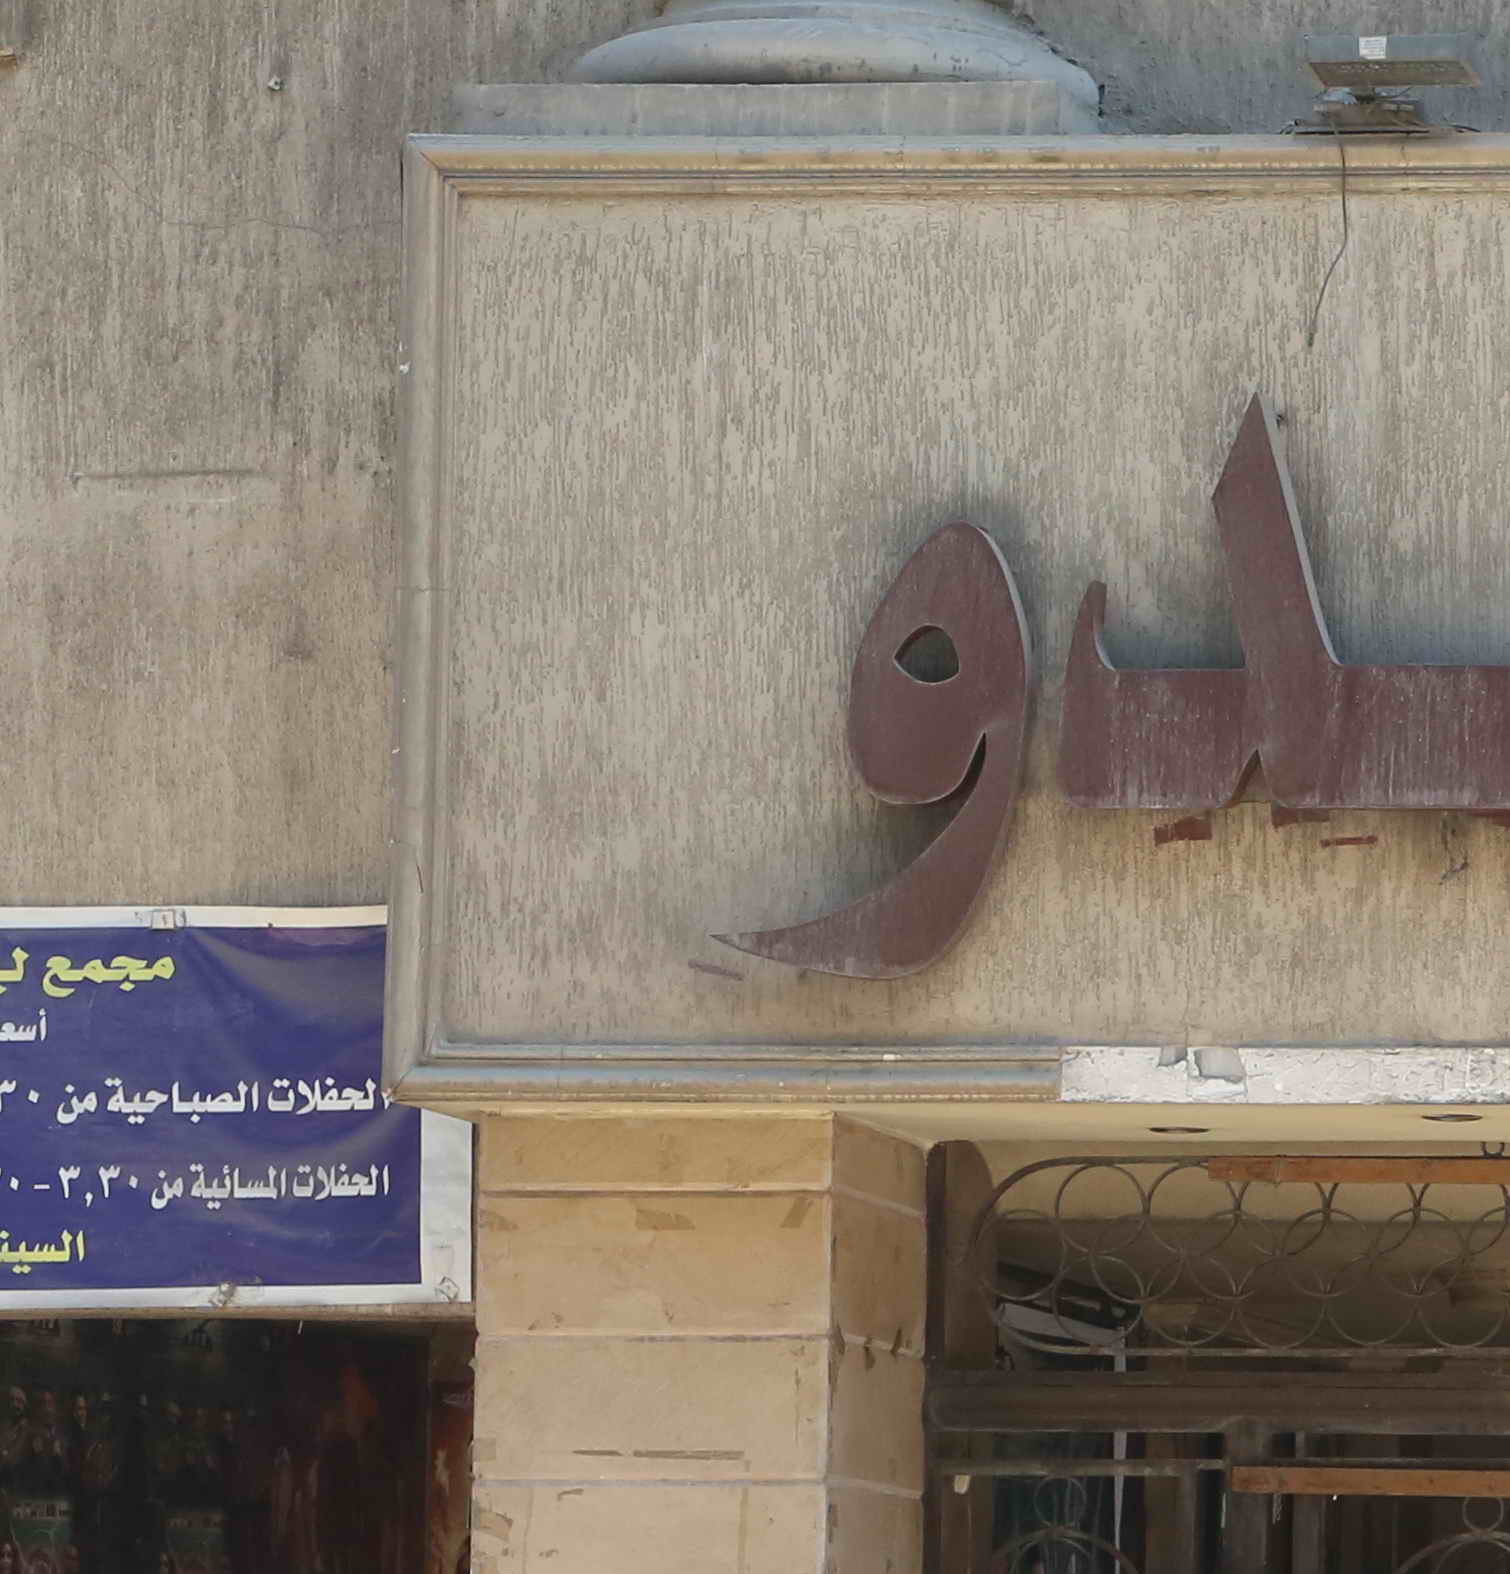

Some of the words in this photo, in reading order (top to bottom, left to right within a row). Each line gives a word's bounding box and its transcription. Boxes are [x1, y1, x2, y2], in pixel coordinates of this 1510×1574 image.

[42, 955, 176, 998] مجمع
[56, 1083, 98, 1124] من
[104, 1077, 259, 1124] الصباحية
[267, 1076, 391, 1115] الحفلات
[151, 1169, 184, 1210] من
[189, 1163, 287, 1210] المسائية
[292, 1162, 390, 1200] الحفلات
